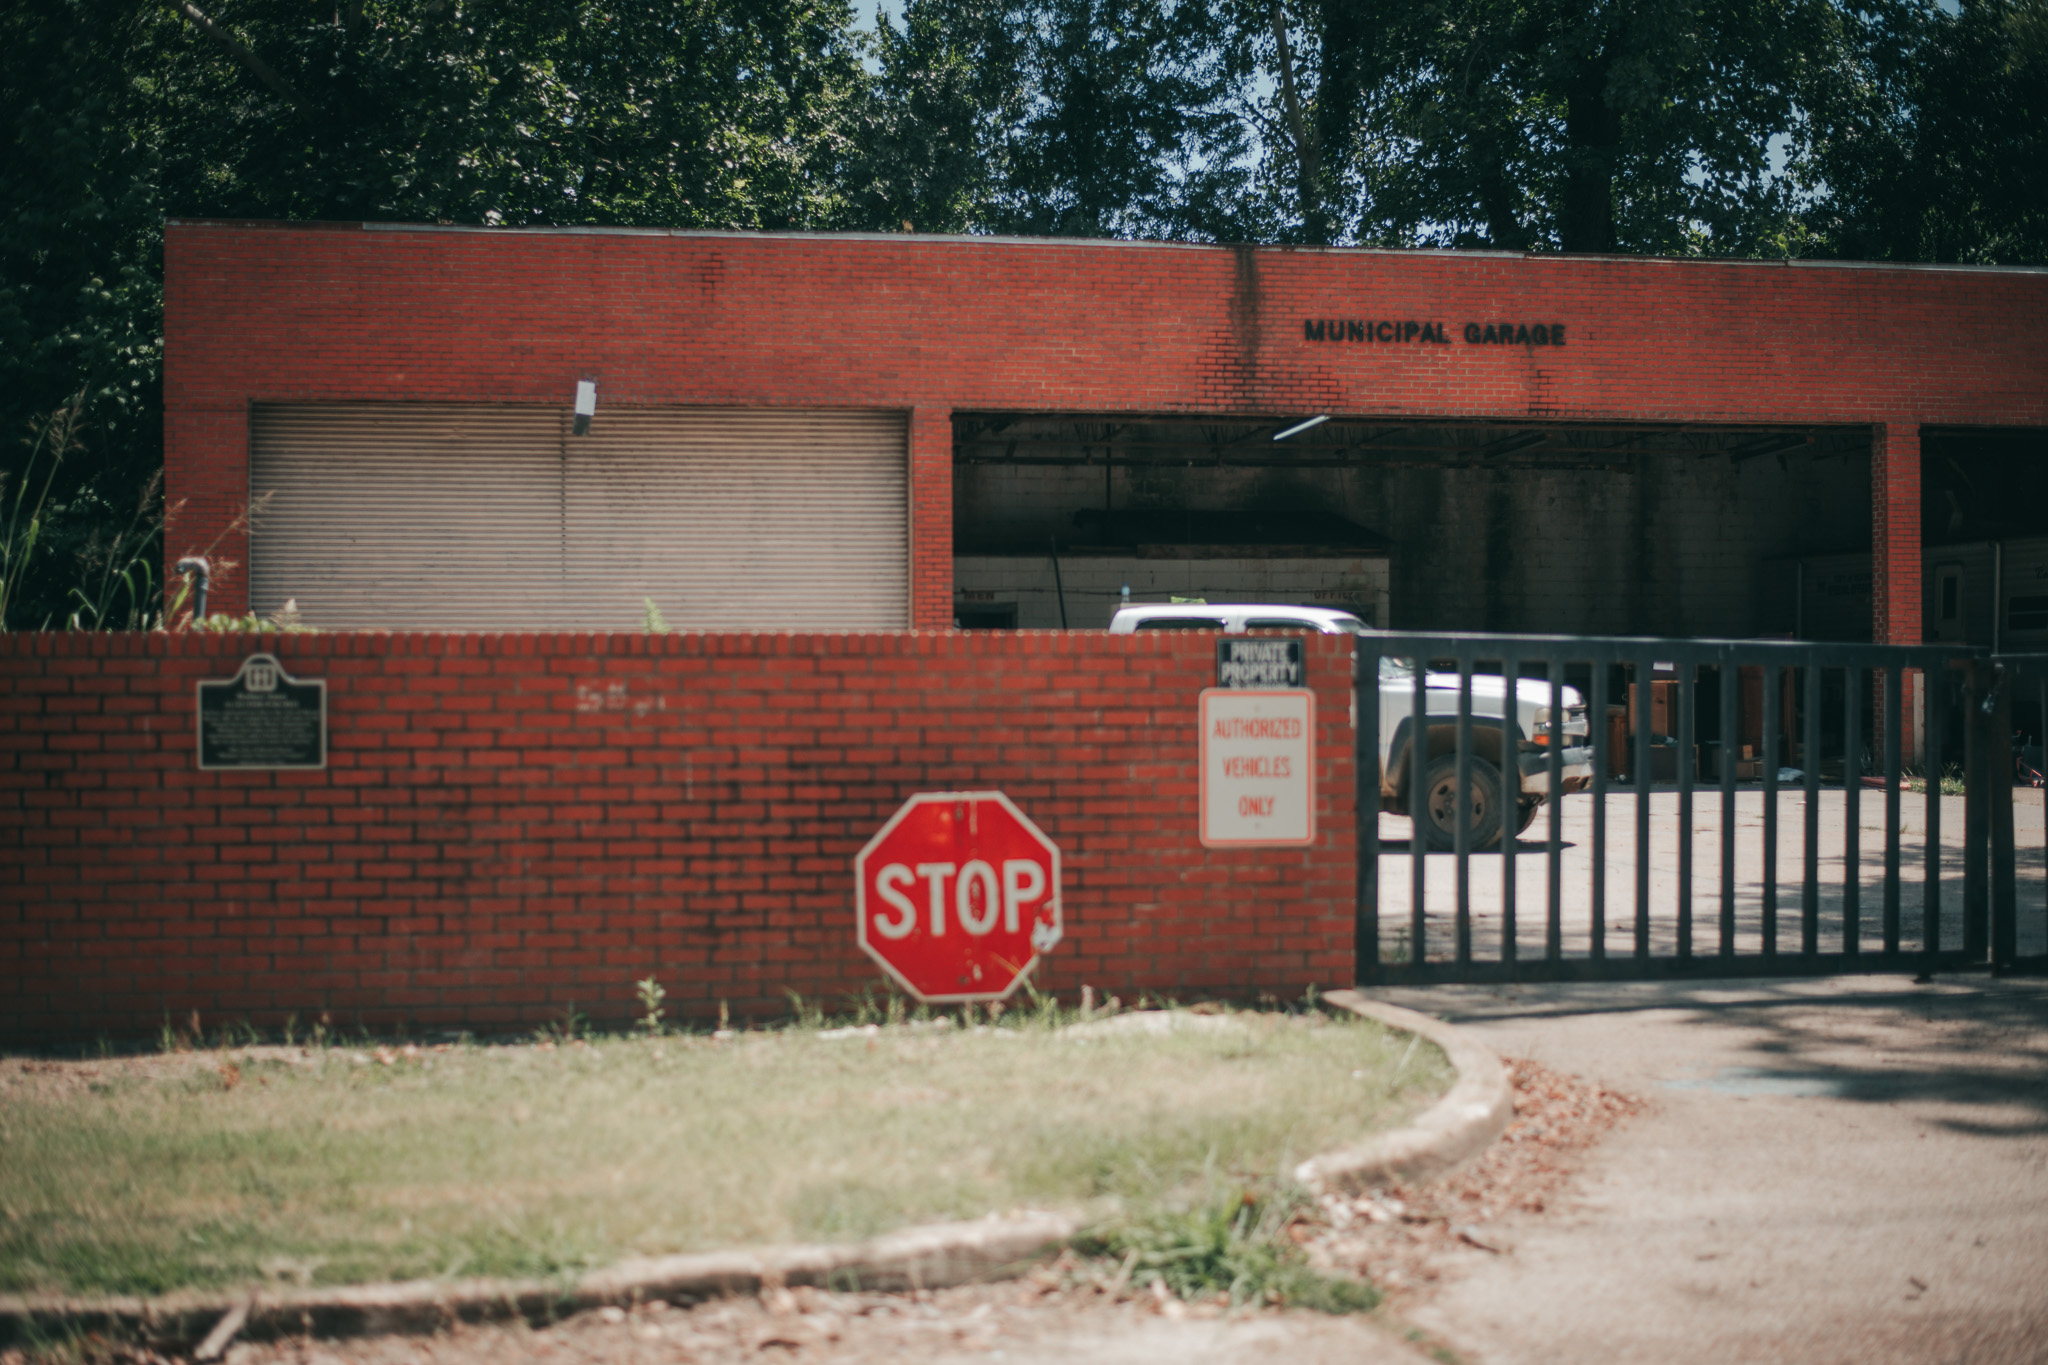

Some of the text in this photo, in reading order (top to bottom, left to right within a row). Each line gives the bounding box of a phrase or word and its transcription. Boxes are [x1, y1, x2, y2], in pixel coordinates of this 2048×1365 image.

[1304, 319, 1566, 346] MUNICIPAL GARAGE
[1231, 641, 1288, 661] PRIVATE
[1221, 661, 1297, 683] PROPERTY
[1213, 717, 1302, 739] AUTHORIZED
[1222, 756, 1291, 778] VEHICLES
[1238, 796, 1275, 817] ONLY
[873, 859, 1046, 939] STOP
